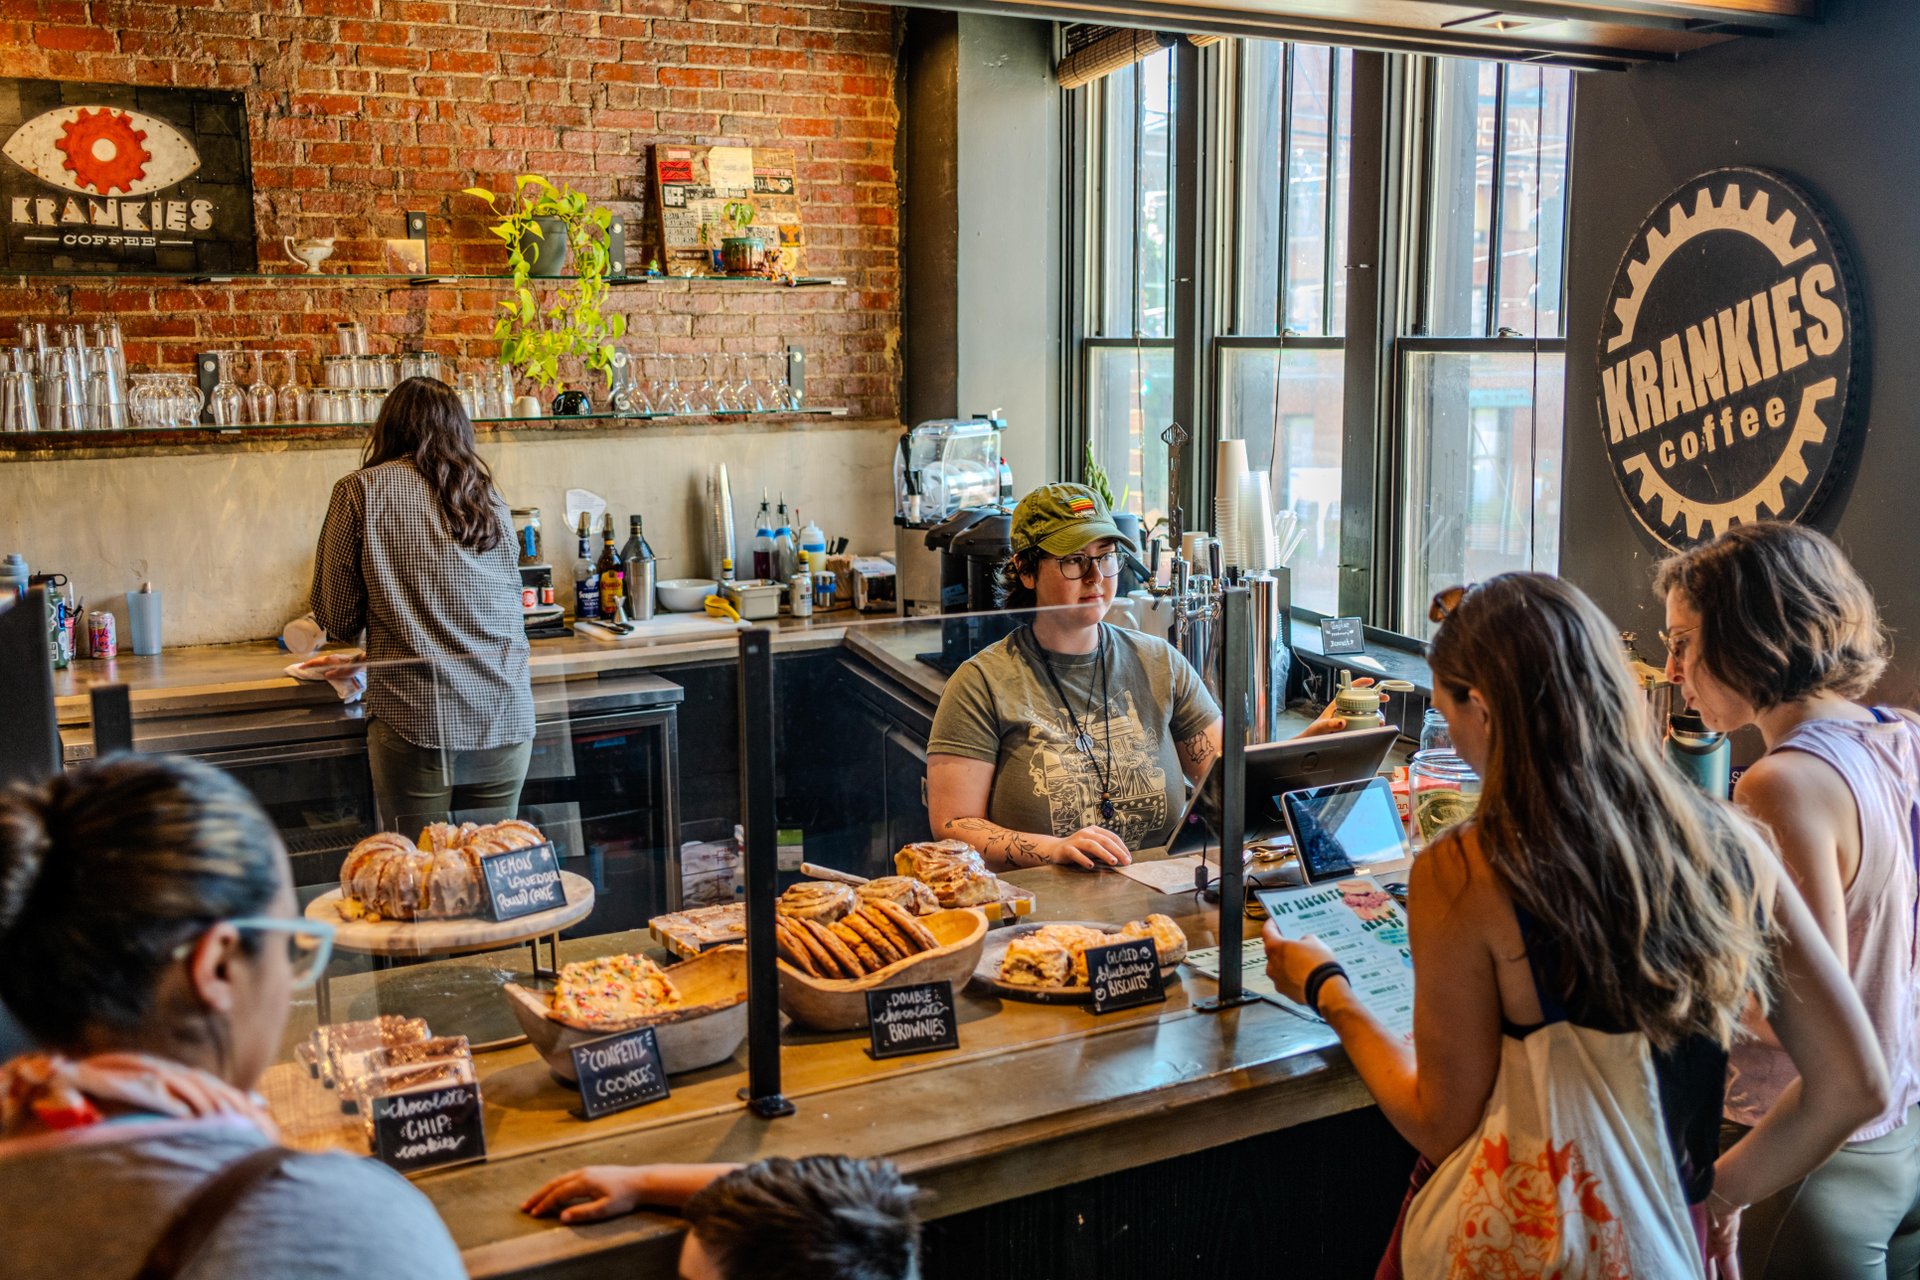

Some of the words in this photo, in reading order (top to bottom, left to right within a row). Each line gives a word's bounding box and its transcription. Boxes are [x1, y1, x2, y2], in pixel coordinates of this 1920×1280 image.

[11, 196, 214, 232] KRANKIES
[63, 234, 156, 247] COFFEE
[1602, 263, 1844, 444] KRANKIES
[1658, 397, 1786, 469] coffee
[494, 852, 532, 878] LEMON
[529, 882, 554, 904] CAKE
[1106, 948, 1138, 965] GLAZED
[1096, 962, 1154, 984] blueberry
[891, 989, 932, 1007] DOUBLE
[1108, 975, 1148, 997] BISCUITS
[875, 1001, 950, 1023] chocolate
[888, 1018, 946, 1042] BROWNIES
[589, 1036, 647, 1072] CONFETTI
[596, 1063, 656, 1097] COOKIES
[406, 1114, 449, 1141] CHIP
